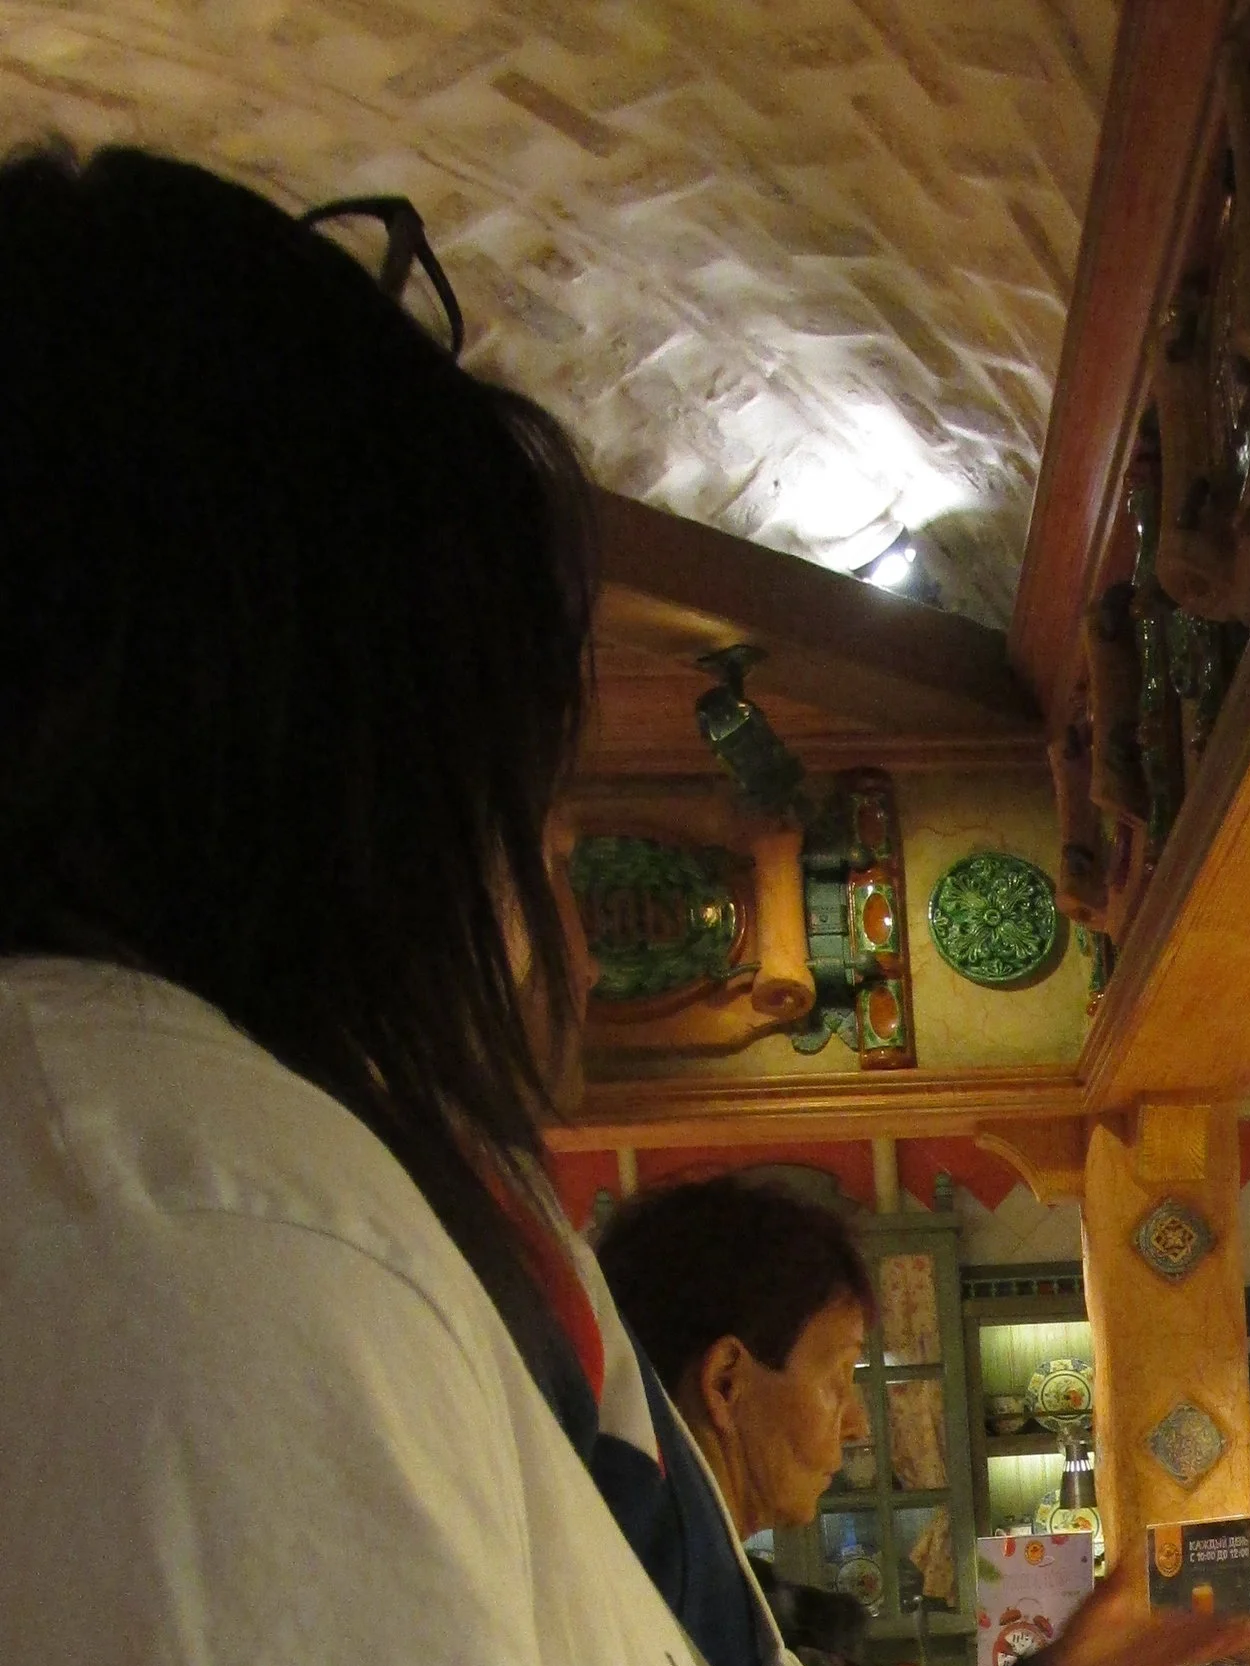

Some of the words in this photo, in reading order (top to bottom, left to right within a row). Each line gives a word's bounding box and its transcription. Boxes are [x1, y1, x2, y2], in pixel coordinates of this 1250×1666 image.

[1188, 1536, 1227, 1551] КАЖДЫЙ
[1228, 1536, 1249, 1550] ДЕНЬ
[1216, 1549, 1228, 1562] ДО
